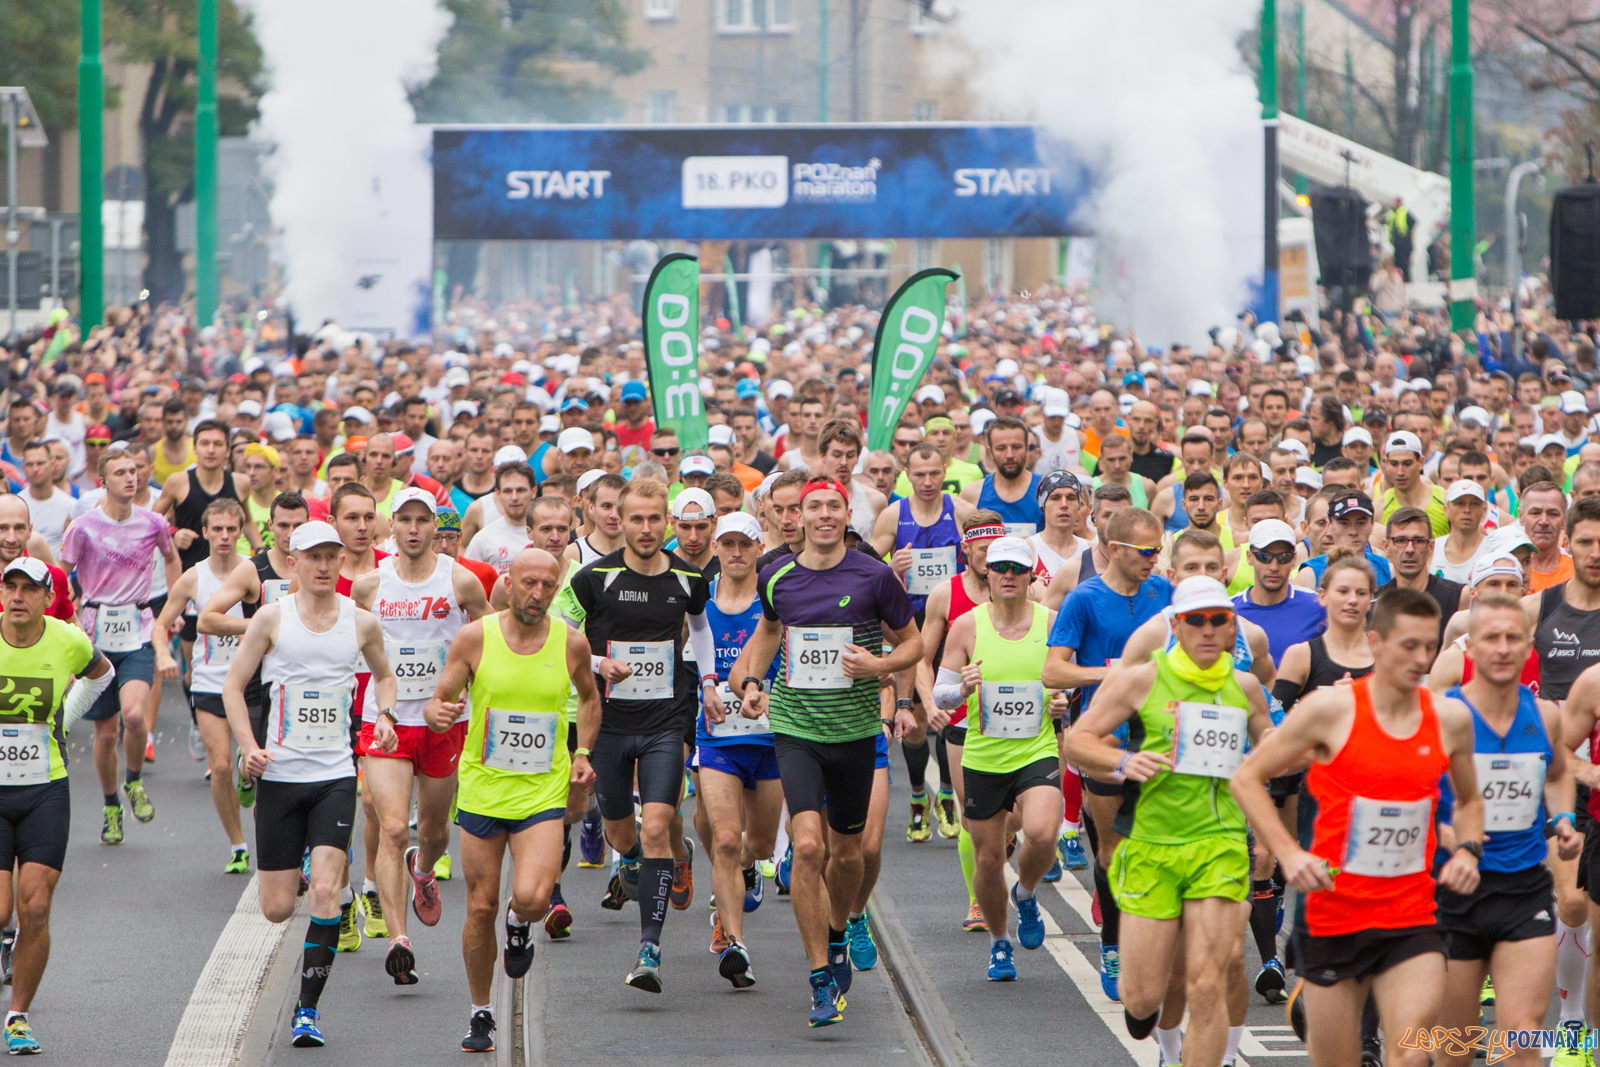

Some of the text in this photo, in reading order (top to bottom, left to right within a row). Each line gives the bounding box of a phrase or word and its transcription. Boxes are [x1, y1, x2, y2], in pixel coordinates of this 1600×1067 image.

[506, 170, 612, 199] START
[696, 170, 778, 190] 18. PKO
[793, 181, 877, 197] maraton
[953, 167, 1055, 197] START
[917, 563, 948, 577] 5531
[618, 590, 649, 602] ADRIAN
[421, 596, 451, 620] 76
[103, 620, 131, 634] 7341
[799, 649, 839, 665] 6817
[395, 661, 437, 678] 6324
[297, 707, 337, 723] 5815
[993, 700, 1034, 716] 4592
[500, 730, 546, 749] 7300
[1193, 728, 1239, 751] 6898
[1482, 780, 1533, 800] 6754
[1367, 826, 1421, 848] 2709
